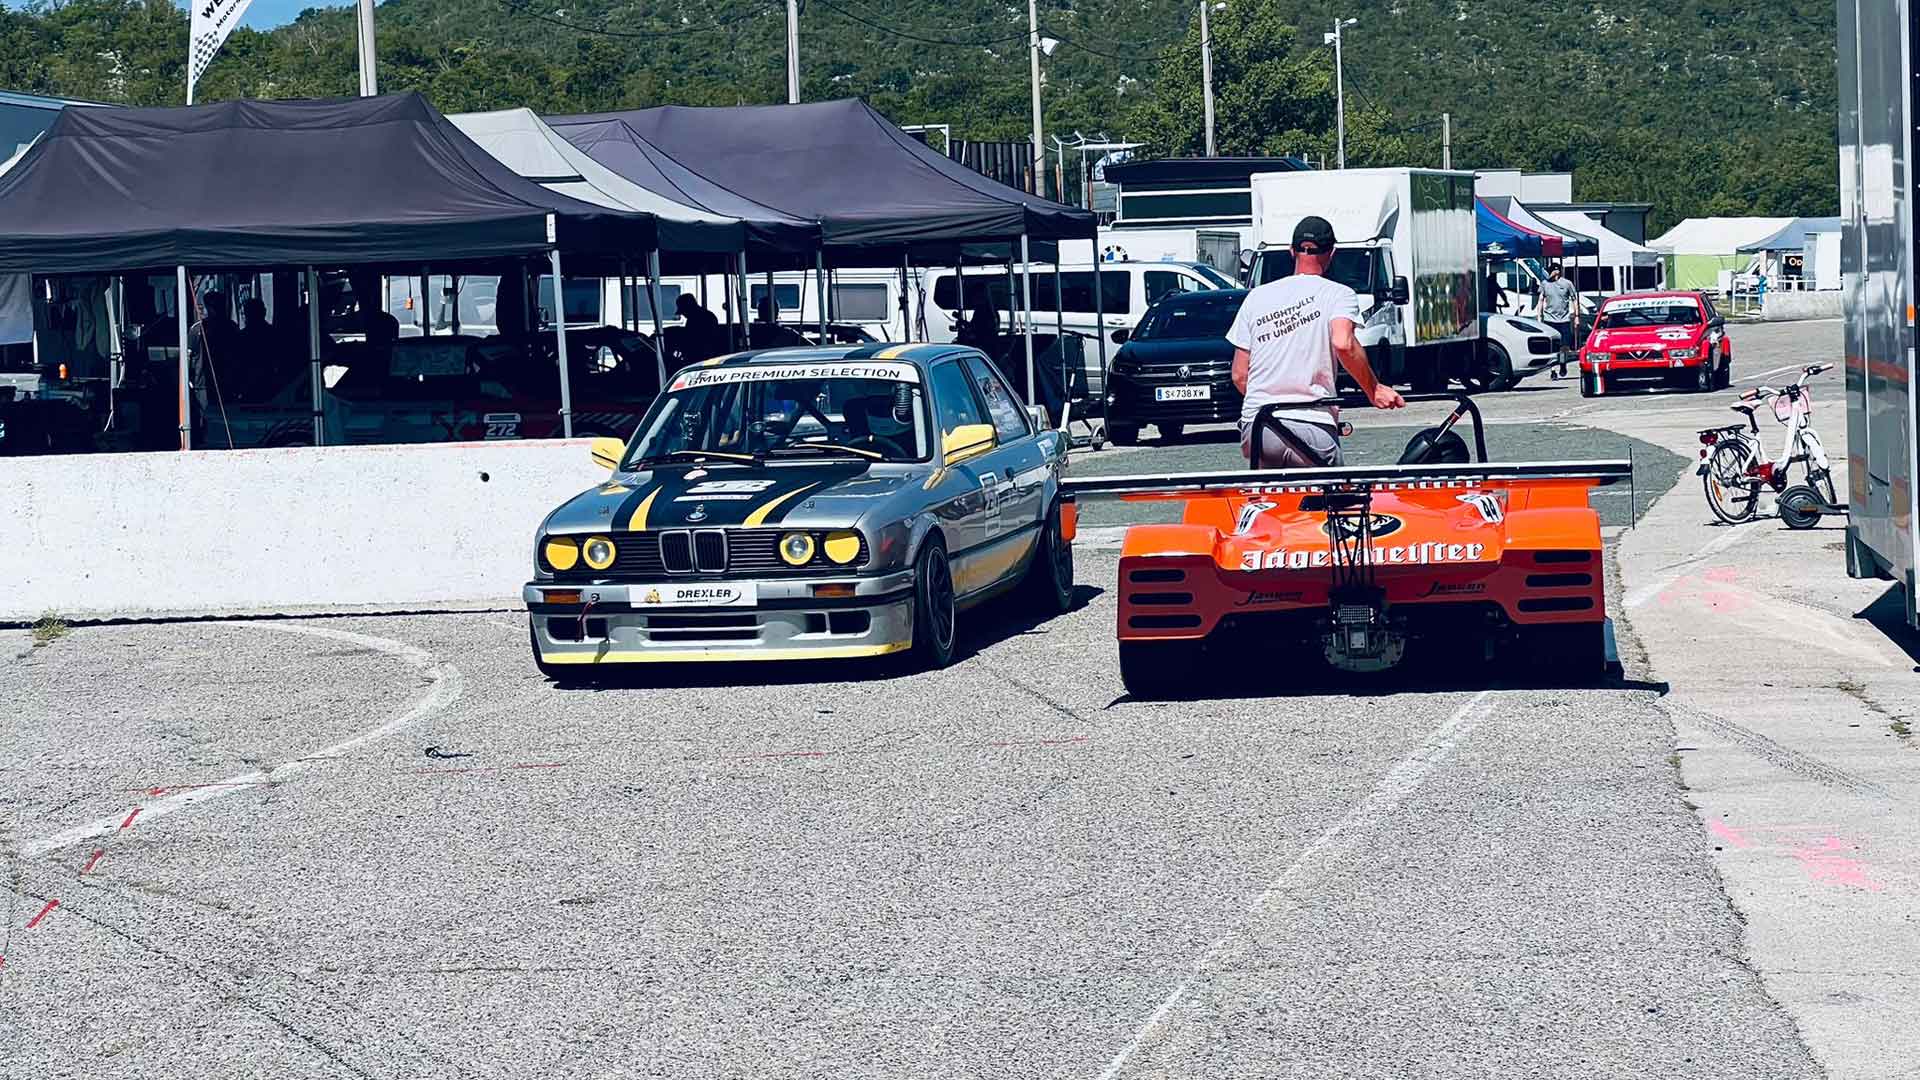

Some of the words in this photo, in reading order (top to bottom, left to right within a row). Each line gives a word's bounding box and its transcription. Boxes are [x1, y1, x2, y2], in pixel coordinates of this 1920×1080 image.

[1256, 296, 1315, 326] DELIGHTFULLY
[1257, 333, 1271, 343] YET
[1273, 310, 1321, 338] UNREFINED
[688, 374, 727, 386] BMW
[730, 369, 806, 380] PREMIUM
[809, 367, 900, 378] SELECTION
[486, 423, 517, 436] 272
[1480, 496, 1500, 521] 44
[676, 589, 731, 598] DREXLER
